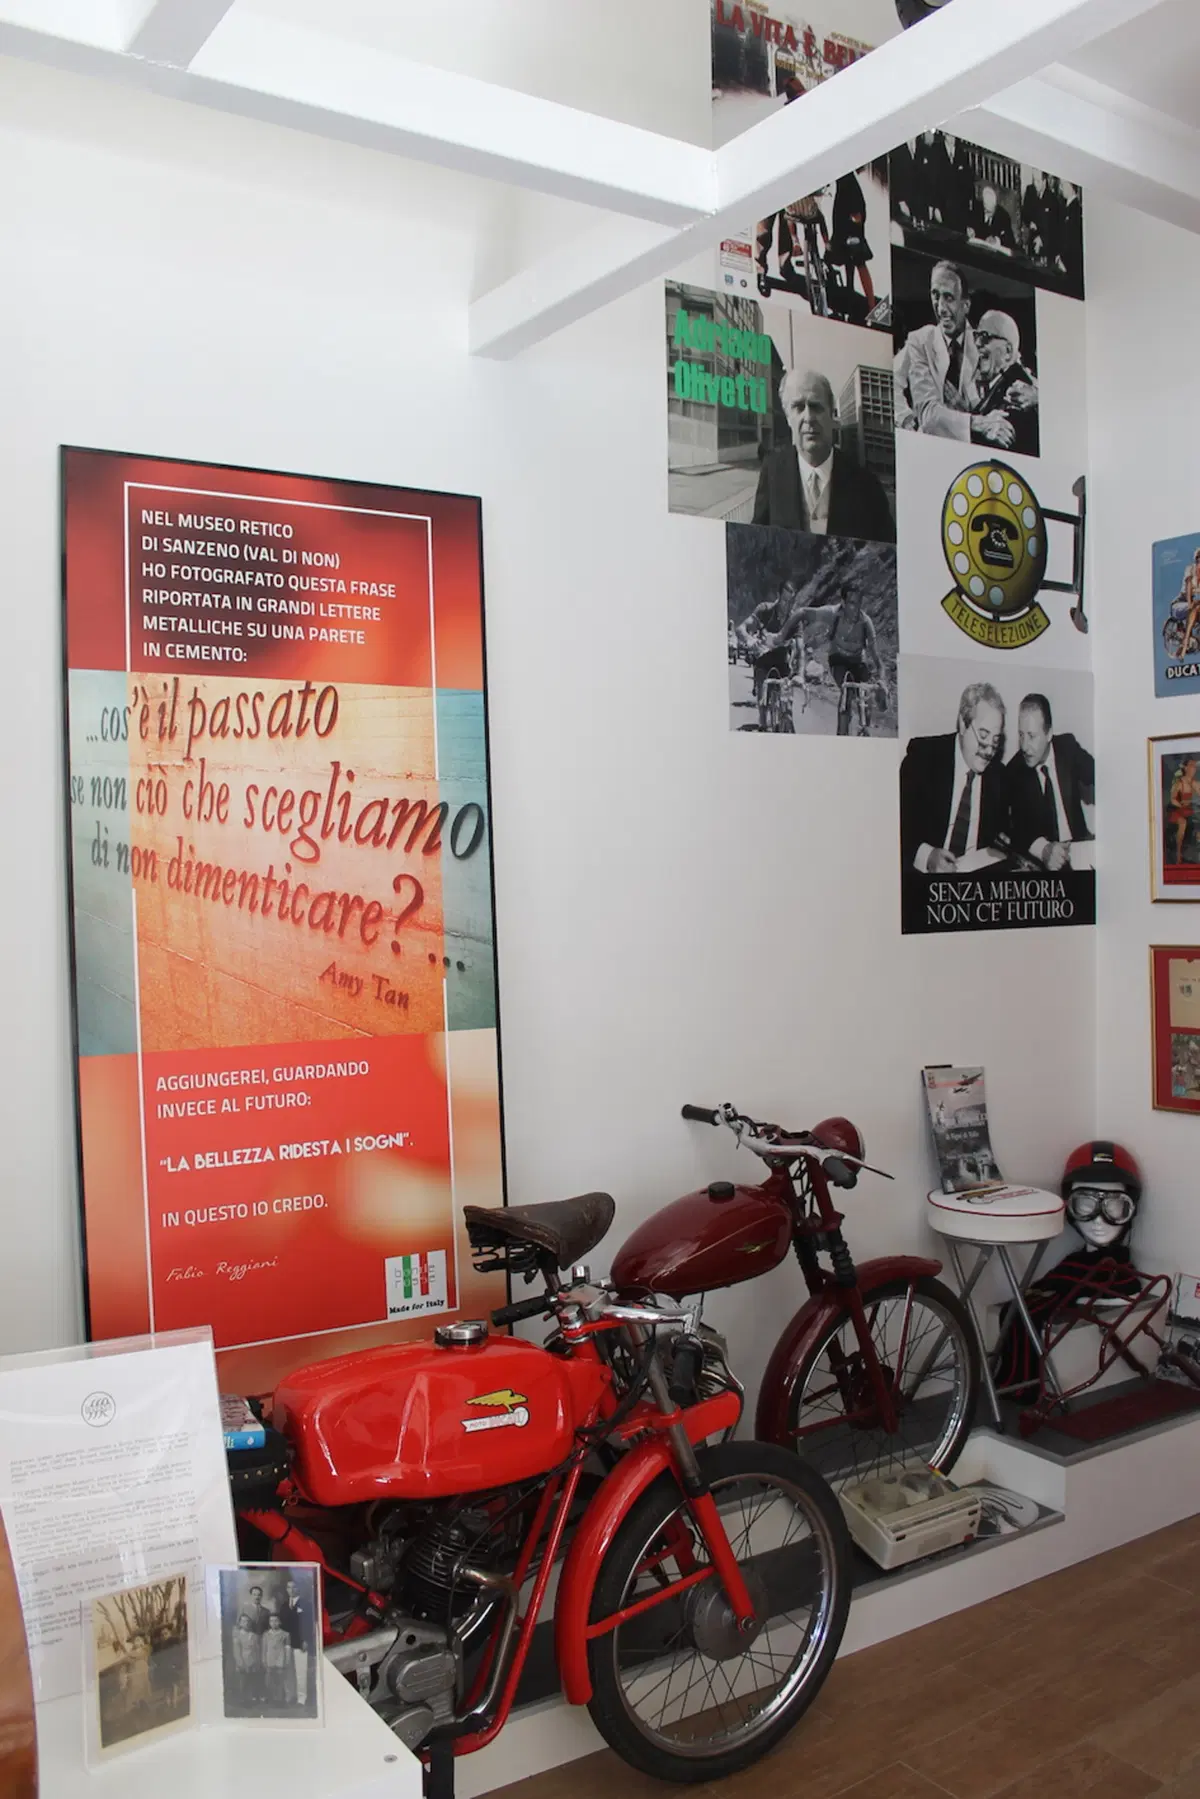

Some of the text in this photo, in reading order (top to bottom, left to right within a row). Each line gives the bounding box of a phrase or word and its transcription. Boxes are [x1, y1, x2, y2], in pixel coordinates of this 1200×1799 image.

[715, 0, 745, 32] LA
[750, 11, 798, 51] VITA
[674, 307, 772, 365] Adriano
[674, 359, 768, 415] Olivetti
[141, 509, 294, 539] NEL MUSEO RETICO
[141, 535, 341, 570] DI SANZENO (VAL DI NON)
[141, 562, 397, 598] HO FOTOGRAFATO QUESTA FRASE
[142, 588, 382, 622] RIPORTATA IN GRANDI LETTERE
[142, 615, 366, 645] METALLICHE SU UNA PARETE
[951, 600, 1043, 645] TELESELEZIONE
[142, 642, 248, 663] IN CEMENTO:
[1167, 664, 1200, 678] DUCA
[157, 676, 180, 743] il
[183, 681, 340, 762] passato
[70, 757, 486, 864] se non ciò che scegliamo
[91, 820, 110, 870] di
[116, 840, 158, 885] non
[929, 880, 1066, 902] SENZA MEMORIA
[927, 903, 971, 924] NON
[1007, 899, 1074, 920] FUTURO
[318, 960, 410, 1010] Amy Tan
[156, 1060, 370, 1092] AGGIUNGEREI, GUARDANDO
[156, 1092, 312, 1119] INVECE AL FUTURO:
[194, 1147, 275, 1170] BELLEZZA
[279, 1140, 342, 1161] RIDESTA
[346, 1138, 351, 1153] I
[162, 1194, 329, 1228] IN QUESTO IO CREDO.
[165, 1255, 279, 1283] Fabio Reggiani
[389, 1299, 445, 1314] Made for Italy
